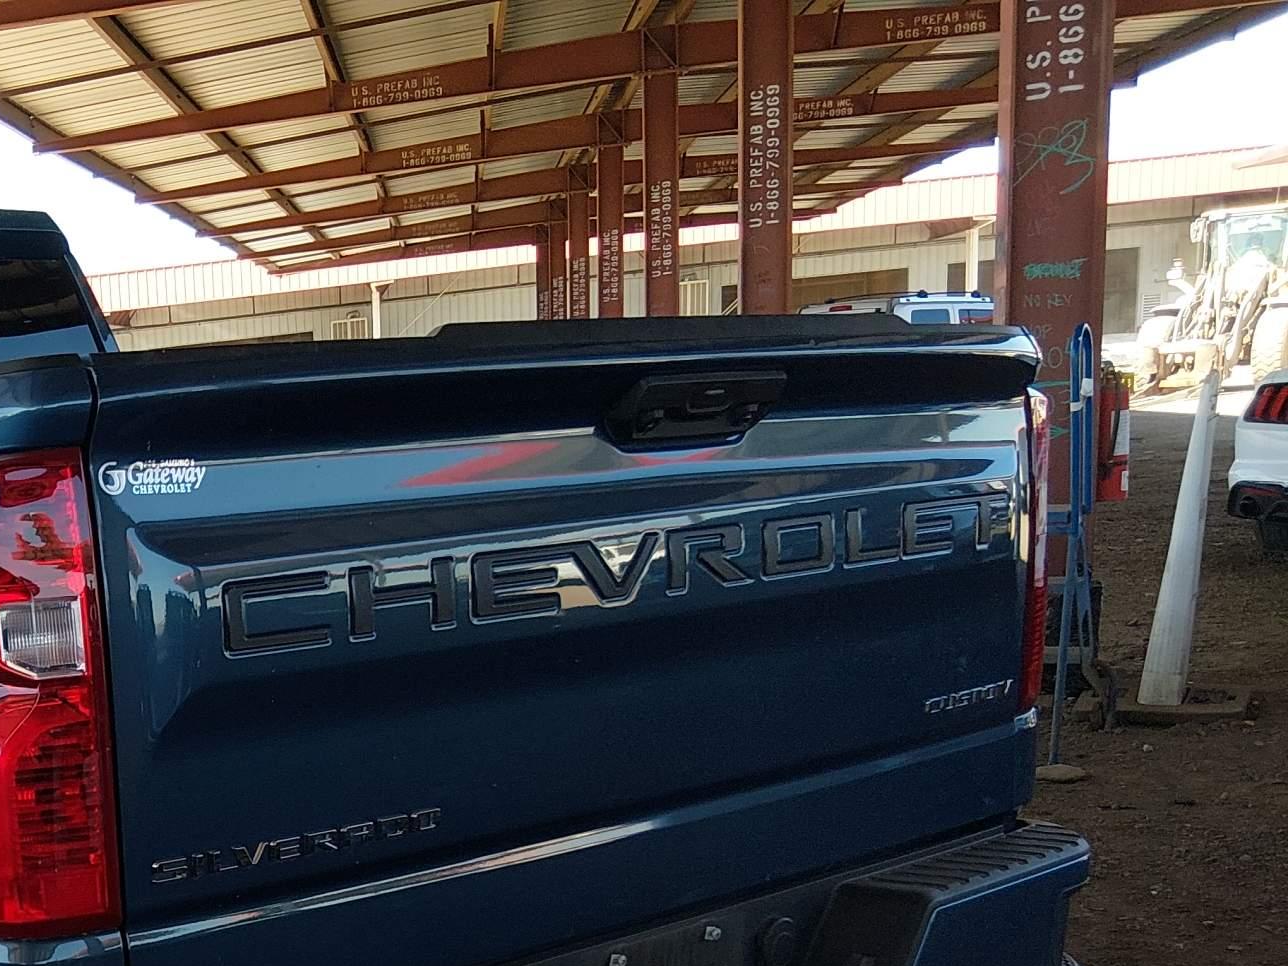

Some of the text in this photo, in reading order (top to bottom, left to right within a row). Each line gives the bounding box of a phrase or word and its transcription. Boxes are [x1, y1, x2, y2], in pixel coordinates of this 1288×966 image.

[914, 11, 960, 27] PREFAB
[1024, 0, 1052, 101] U.S. P
[376, 78, 418, 95] PREFAB
[749, 83, 763, 229] U.S. PREFAB INC.
[765, 83, 781, 226] 1-866-799-0969
[651, 207, 662, 251] PREFAB
[127, 461, 206, 489] Gateway
[132, 483, 193, 495] CHEVROLET
[220, 490, 1011, 661] CHEVROLET
[151, 807, 442, 884] SILVERADO
